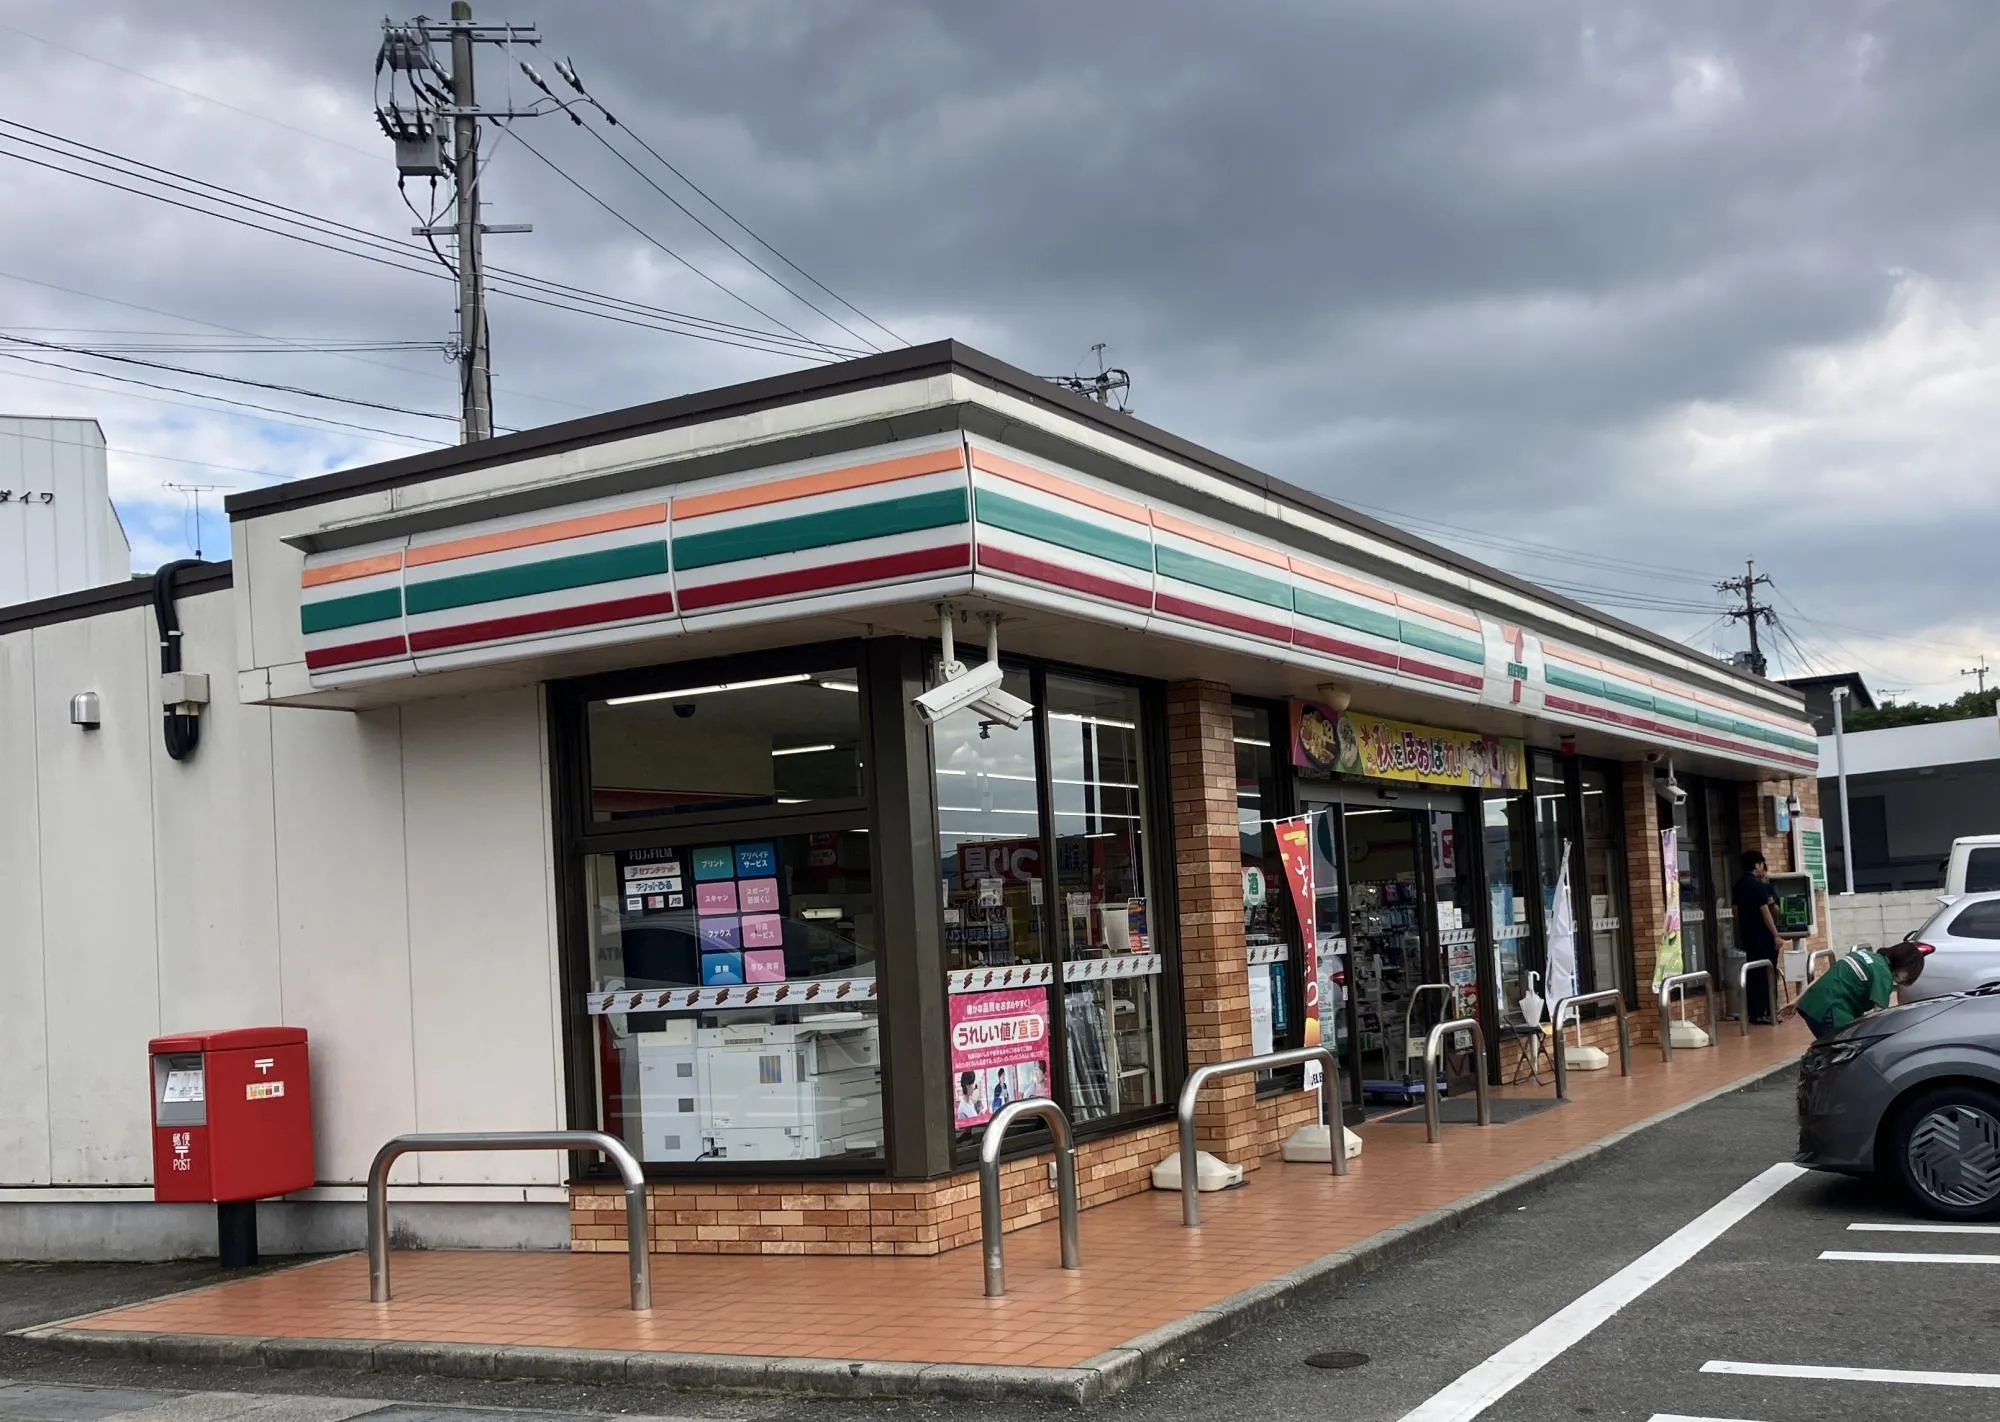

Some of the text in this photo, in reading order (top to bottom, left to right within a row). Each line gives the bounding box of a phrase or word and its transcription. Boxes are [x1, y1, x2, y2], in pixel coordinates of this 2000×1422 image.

[701, 860, 724, 868] プリント
[743, 860, 768, 869] サービス
[705, 894, 728, 903] スキャン
[173, 1158, 191, 1171] POST
